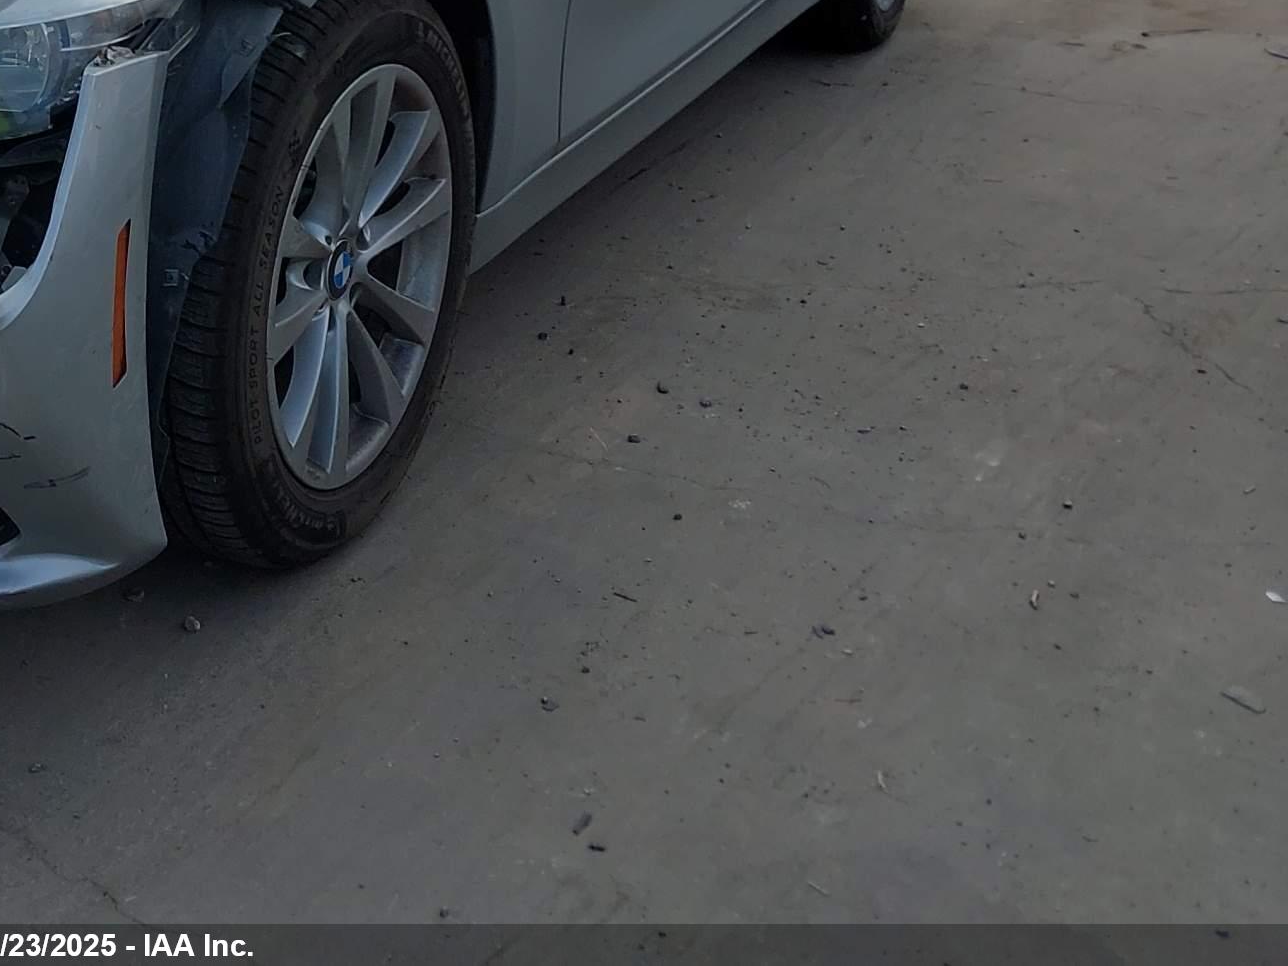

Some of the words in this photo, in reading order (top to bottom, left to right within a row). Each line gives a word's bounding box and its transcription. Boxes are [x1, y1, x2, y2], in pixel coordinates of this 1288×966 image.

[253, 281, 264, 317] ALL
[248, 324, 259, 389] SPORT
[249, 398, 264, 445] PILOT
